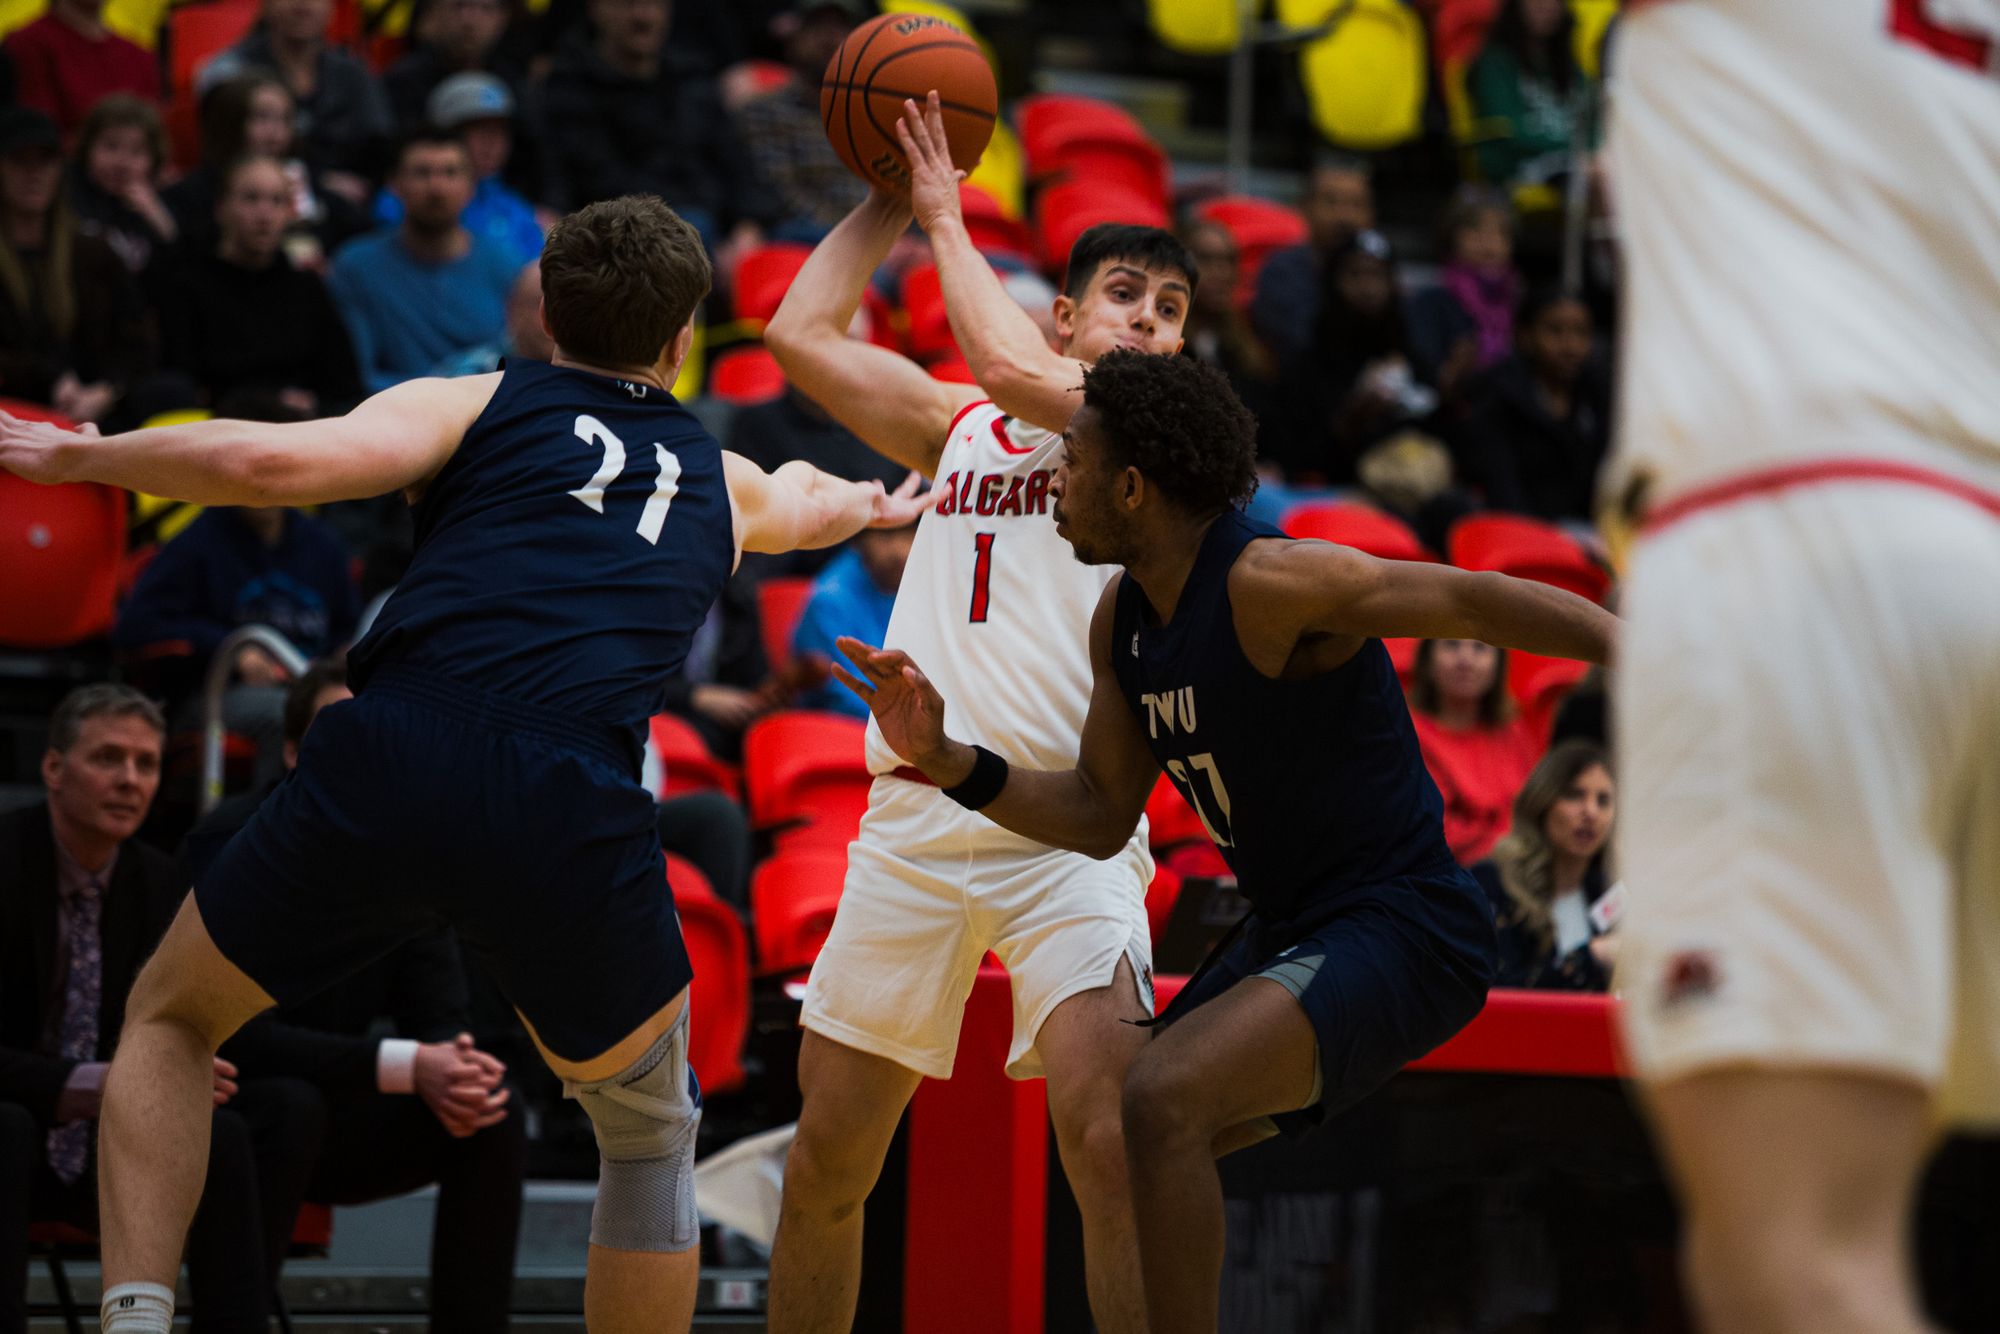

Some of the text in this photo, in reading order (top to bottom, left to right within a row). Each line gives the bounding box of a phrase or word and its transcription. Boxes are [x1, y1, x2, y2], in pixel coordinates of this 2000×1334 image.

[566, 414, 682, 546] 21
[936, 469, 1058, 516] ALGAR
[969, 532, 995, 623] 1
[1141, 685, 1197, 739] TWU
